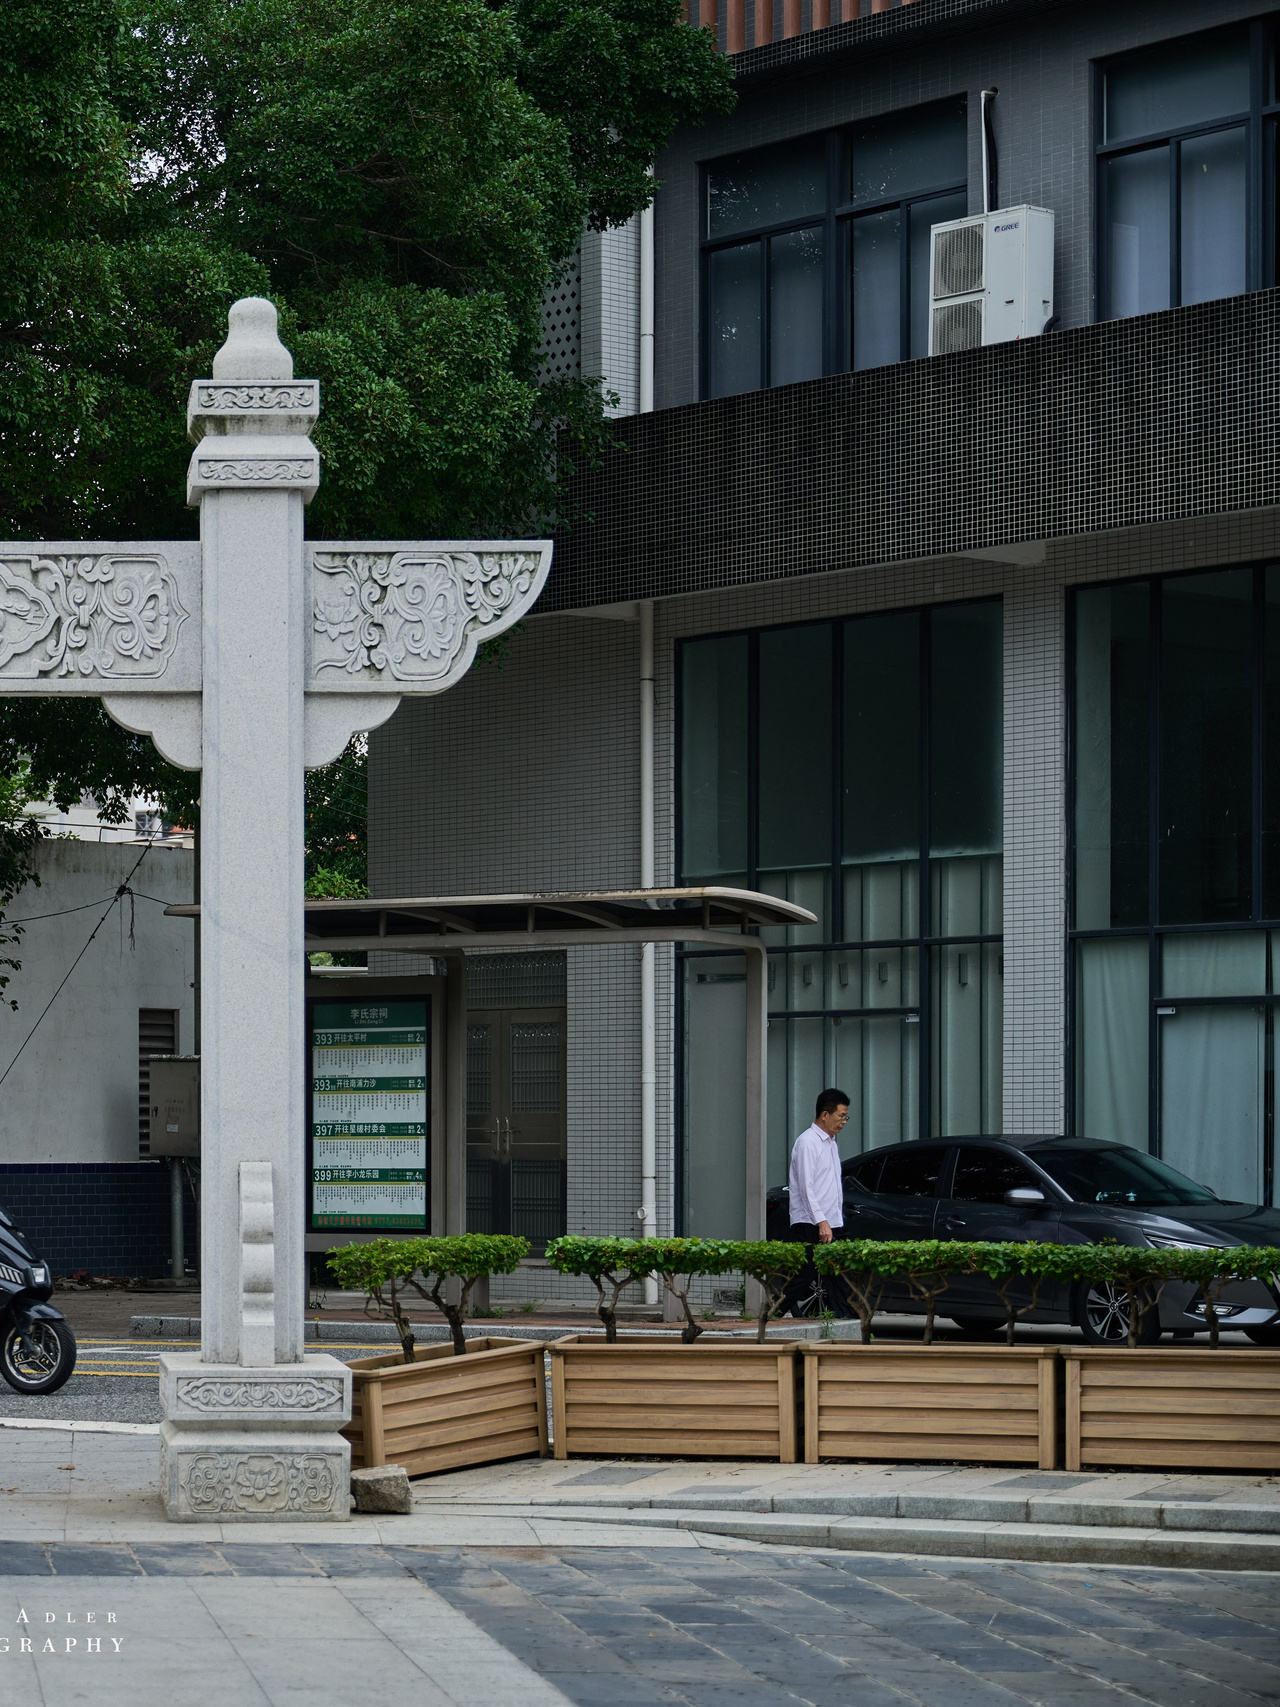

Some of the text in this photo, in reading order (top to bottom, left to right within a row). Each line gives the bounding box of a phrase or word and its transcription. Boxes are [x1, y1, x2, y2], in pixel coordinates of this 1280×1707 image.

[1001, 221, 1019, 231] GREE
[350, 1008, 388, 1019] 李氏宗祠
[315, 1033, 332, 1045] 393
[333, 1033, 367, 1042] 开往太平村
[314, 1079, 331, 1091] 393
[315, 1125, 333, 1136] 397
[314, 1170, 331, 1181] 399
[332, 1169, 379, 1179] 开往李小龙乐园
